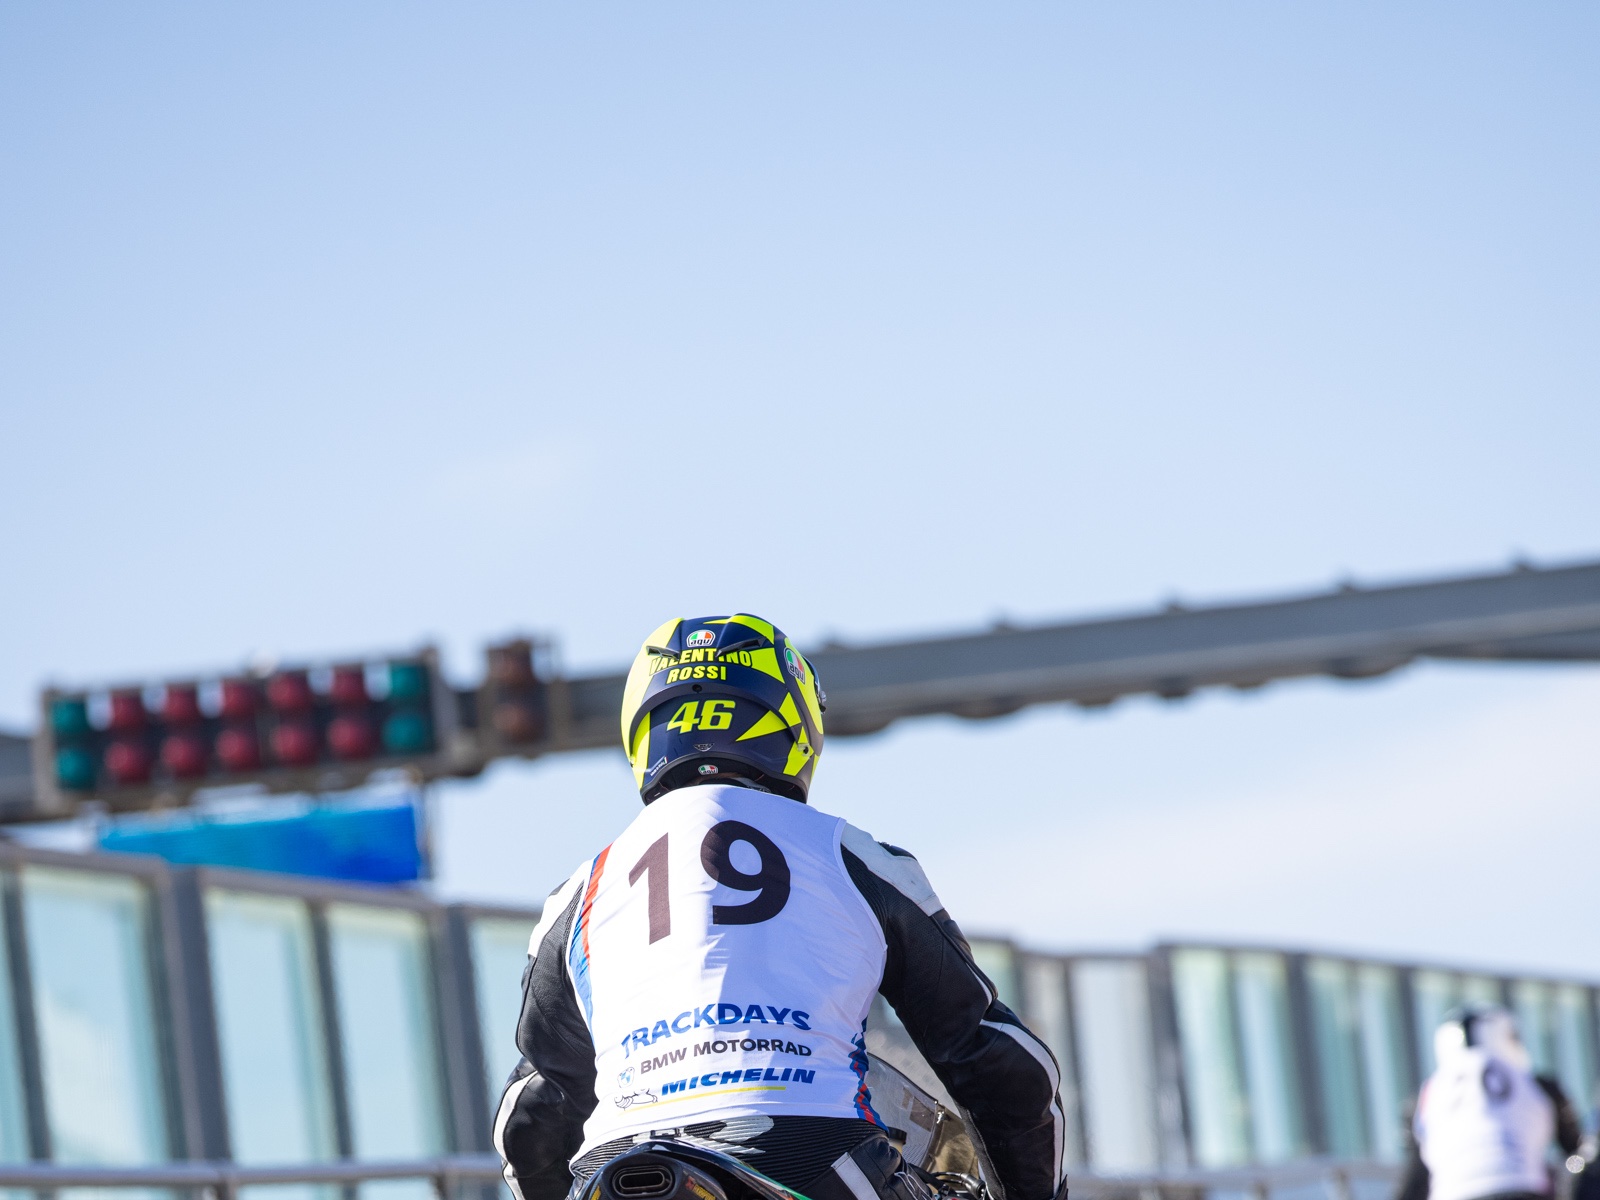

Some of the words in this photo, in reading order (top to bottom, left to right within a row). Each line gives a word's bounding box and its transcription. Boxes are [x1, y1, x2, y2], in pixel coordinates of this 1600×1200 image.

[666, 665, 727, 685] ROSSI
[666, 700, 736, 734] 46
[628, 820, 791, 946] 19
[621, 1003, 812, 1059] TRACKDAYS
[640, 1047, 687, 1075] BMW
[693, 1038, 812, 1057] MOTORRAD
[661, 1067, 816, 1096] MICHELIN
